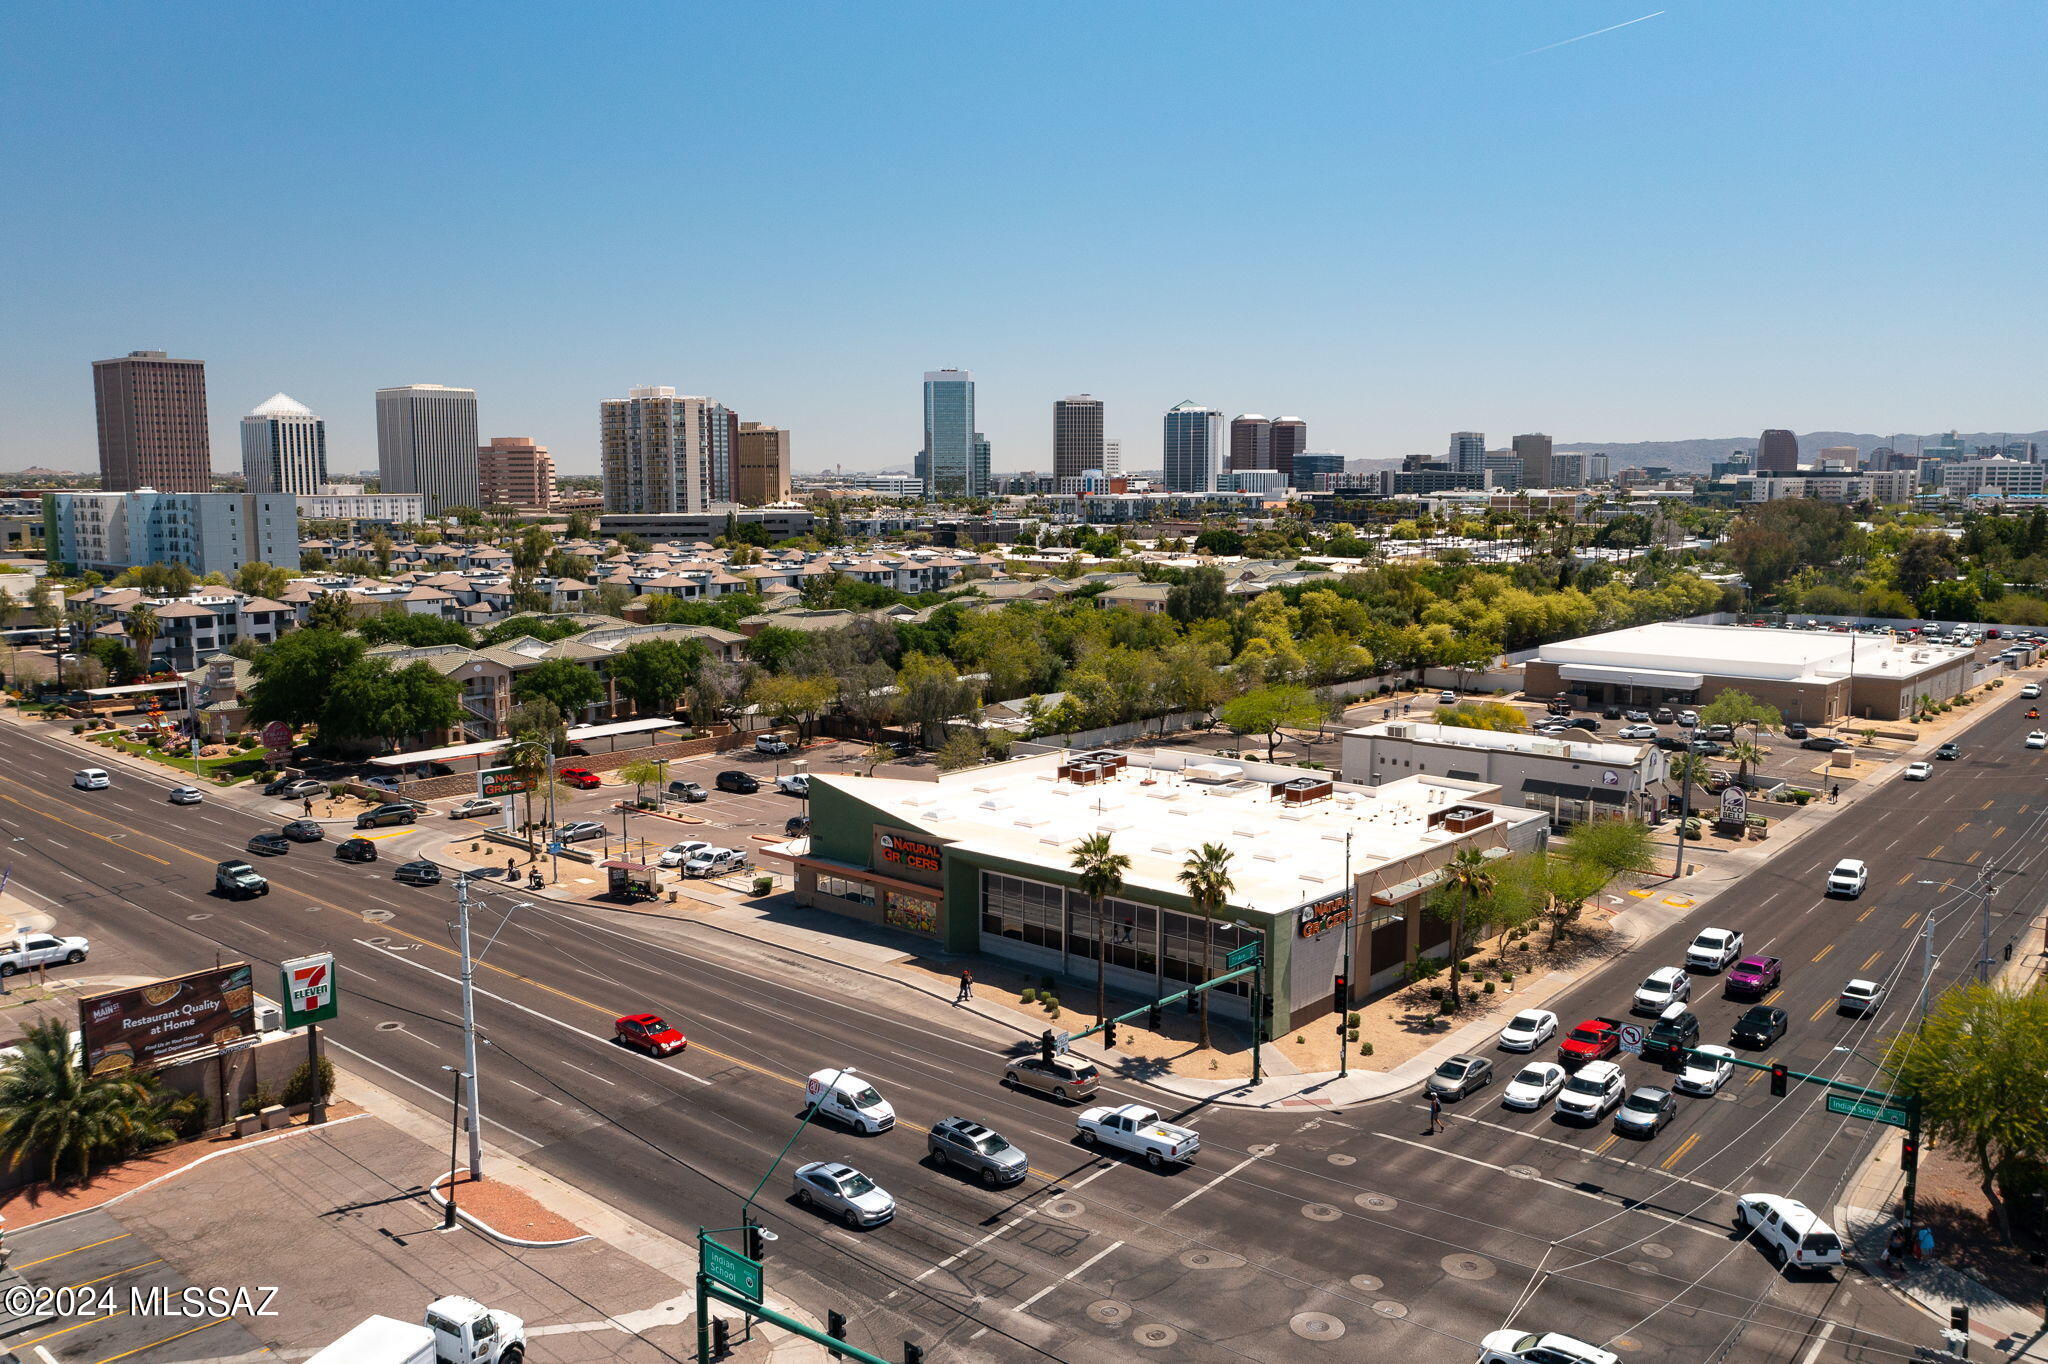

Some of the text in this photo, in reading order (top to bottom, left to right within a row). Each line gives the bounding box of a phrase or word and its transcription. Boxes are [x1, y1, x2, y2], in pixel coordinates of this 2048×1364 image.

[893, 836, 940, 858] NATURAL
[882, 848, 939, 871] GROCERS
[294, 964, 327, 1010] 7
[93, 1005, 114, 1019] MAIN
[122, 999, 221, 1030] Restaurant Quality
[150, 1018, 196, 1036] at Home
[1833, 1101, 1856, 1112] Indian
[711, 1252, 735, 1270] Indian
[710, 1262, 736, 1282] School
